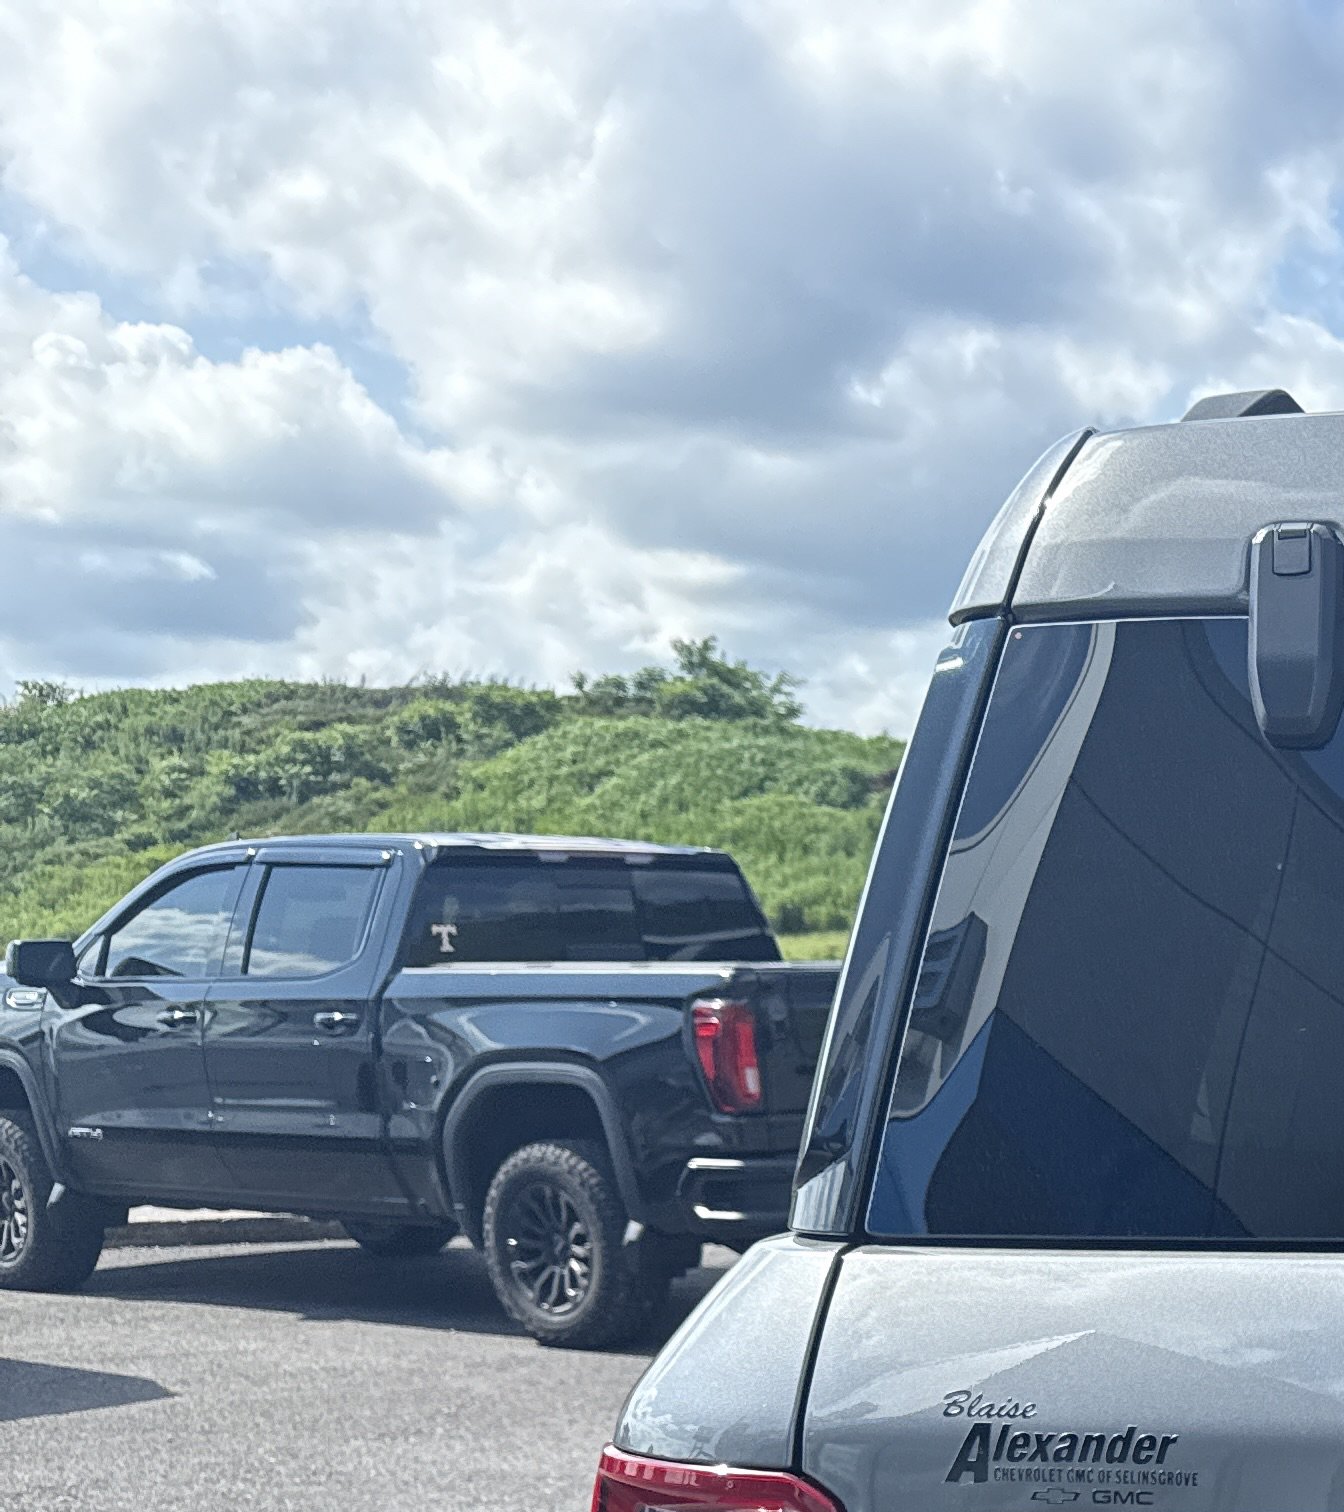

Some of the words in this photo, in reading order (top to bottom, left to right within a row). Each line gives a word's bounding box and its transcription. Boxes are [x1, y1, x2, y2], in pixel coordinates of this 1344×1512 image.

[943, 1389, 1037, 1420] Blaise
[944, 1422, 1179, 1484] Alexander
[993, 1467, 1062, 1484] CHEVROLET
[1066, 1468, 1094, 1484] GMC
[1097, 1469, 1113, 1485] OF
[1115, 1469, 1199, 1488] SELINSGROVE
[1092, 1489, 1154, 1506] GMC
